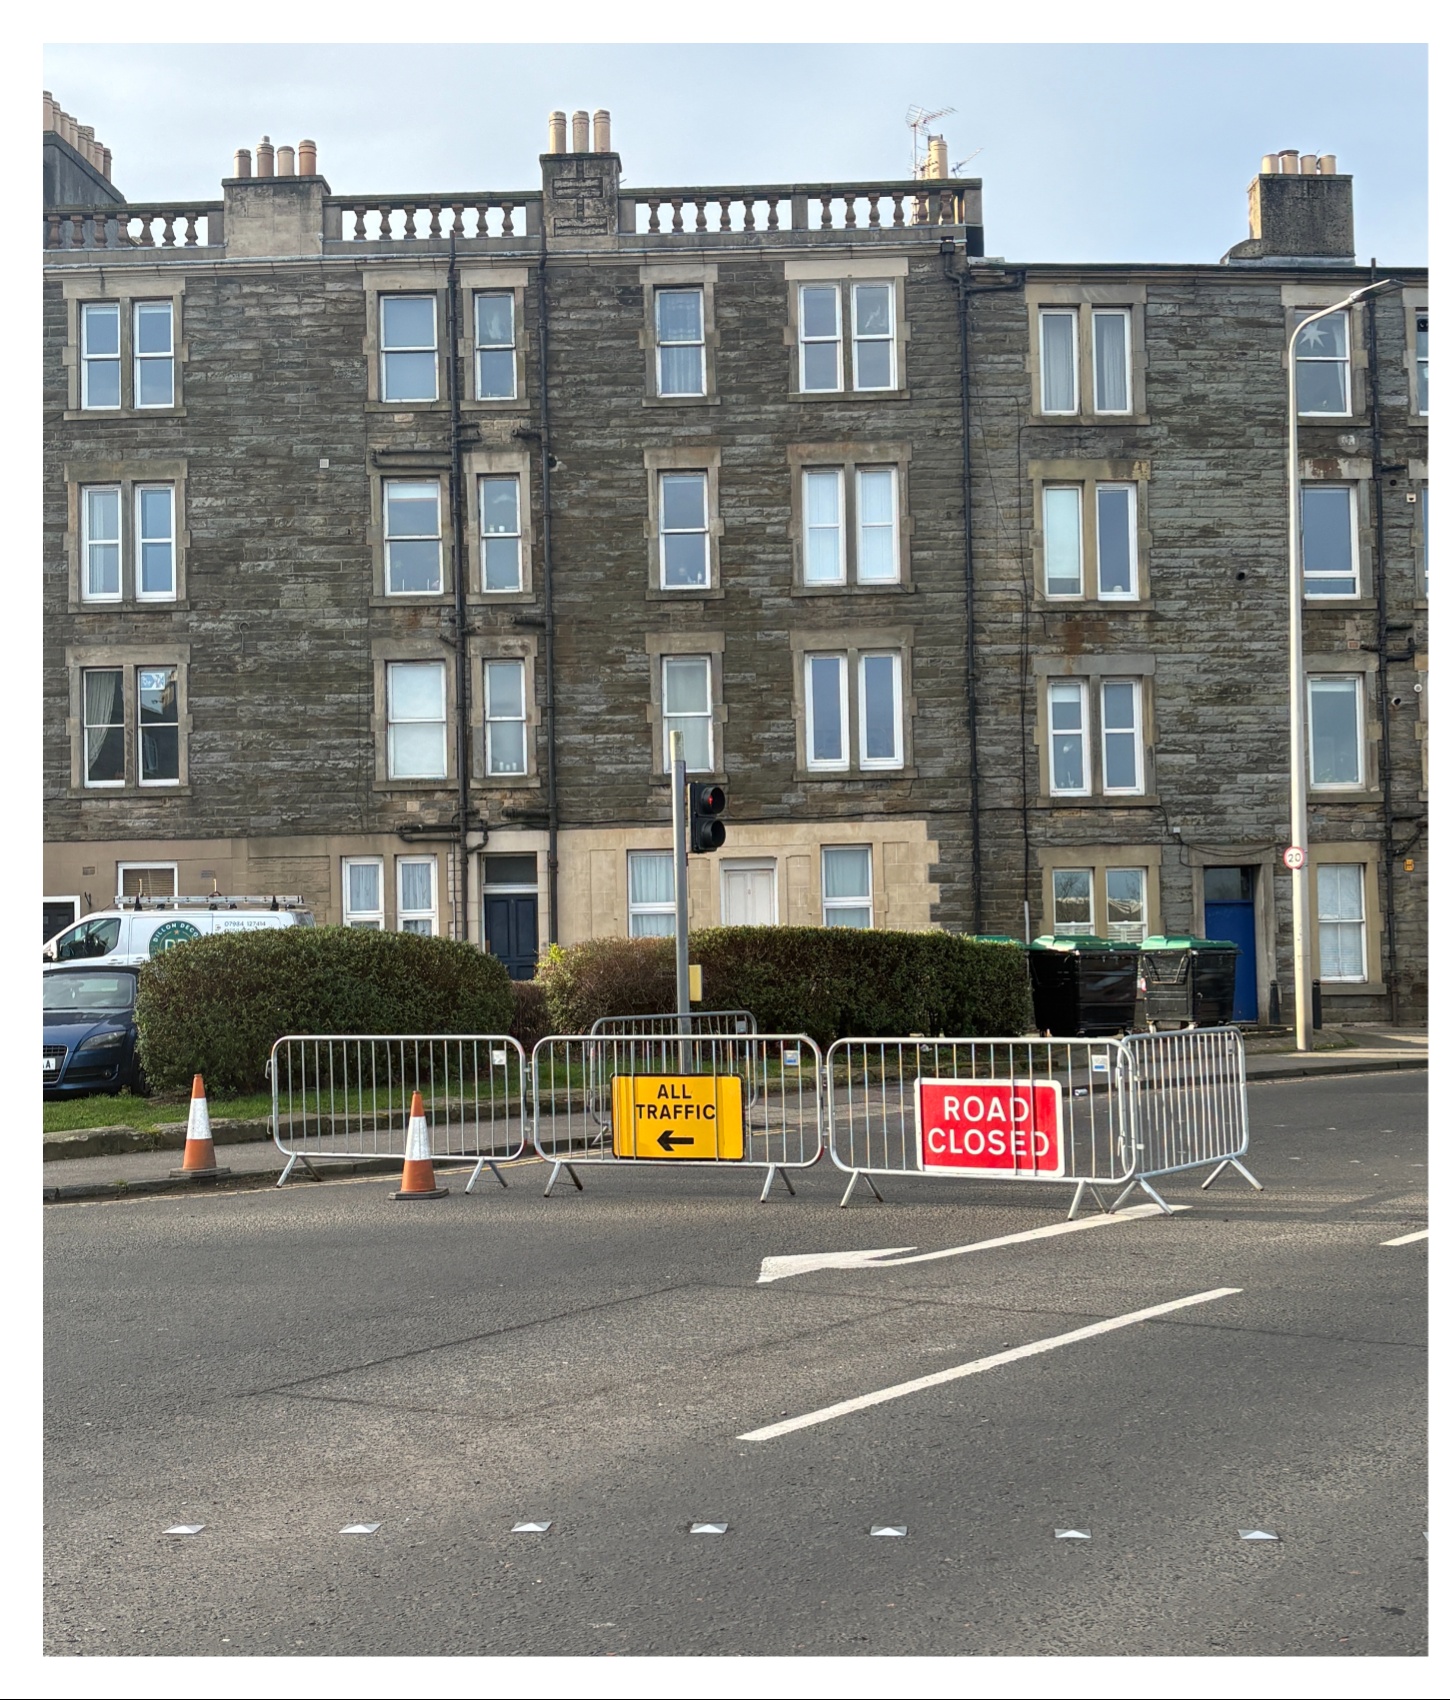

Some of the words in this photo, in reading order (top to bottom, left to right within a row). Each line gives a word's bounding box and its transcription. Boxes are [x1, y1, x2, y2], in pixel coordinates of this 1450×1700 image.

[1288, 853, 1301, 863] 20
[153, 922, 177, 942] DILLON
[657, 1084, 692, 1099] ALL
[635, 1104, 716, 1120] TRAFFIC
[943, 1095, 1029, 1122] ROAD
[927, 1127, 1050, 1157] CLOSED
